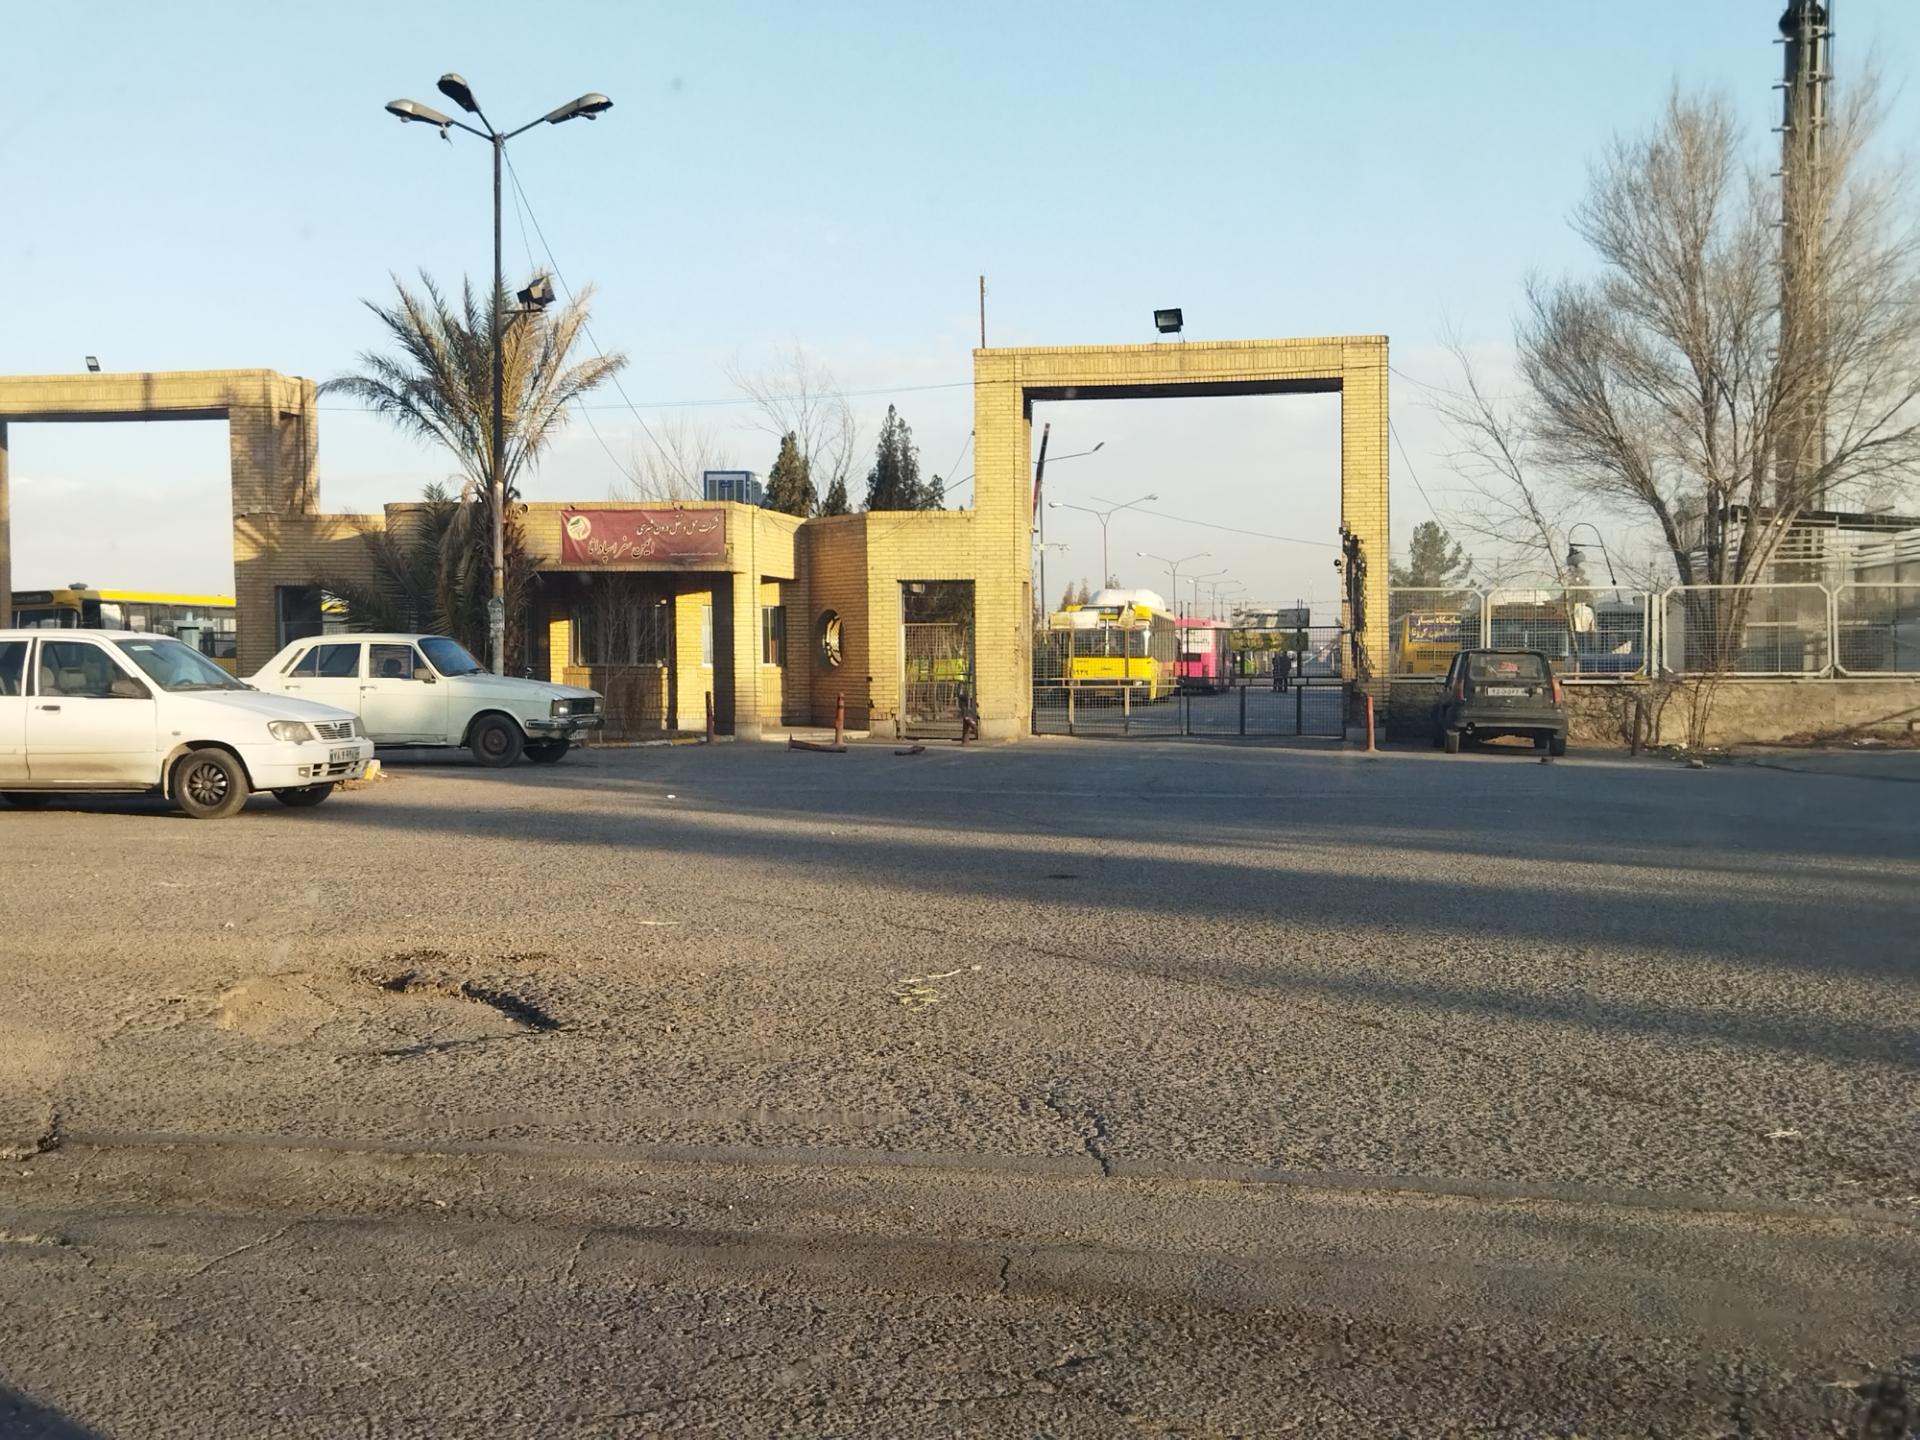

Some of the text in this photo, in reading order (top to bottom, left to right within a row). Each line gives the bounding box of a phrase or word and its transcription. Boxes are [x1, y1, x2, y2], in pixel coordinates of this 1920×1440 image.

[636, 518, 655, 536] شهری
[654, 522, 669, 536] درون
[699, 513, 720, 534] شرکت
[631, 537, 656, 560] ایمن
